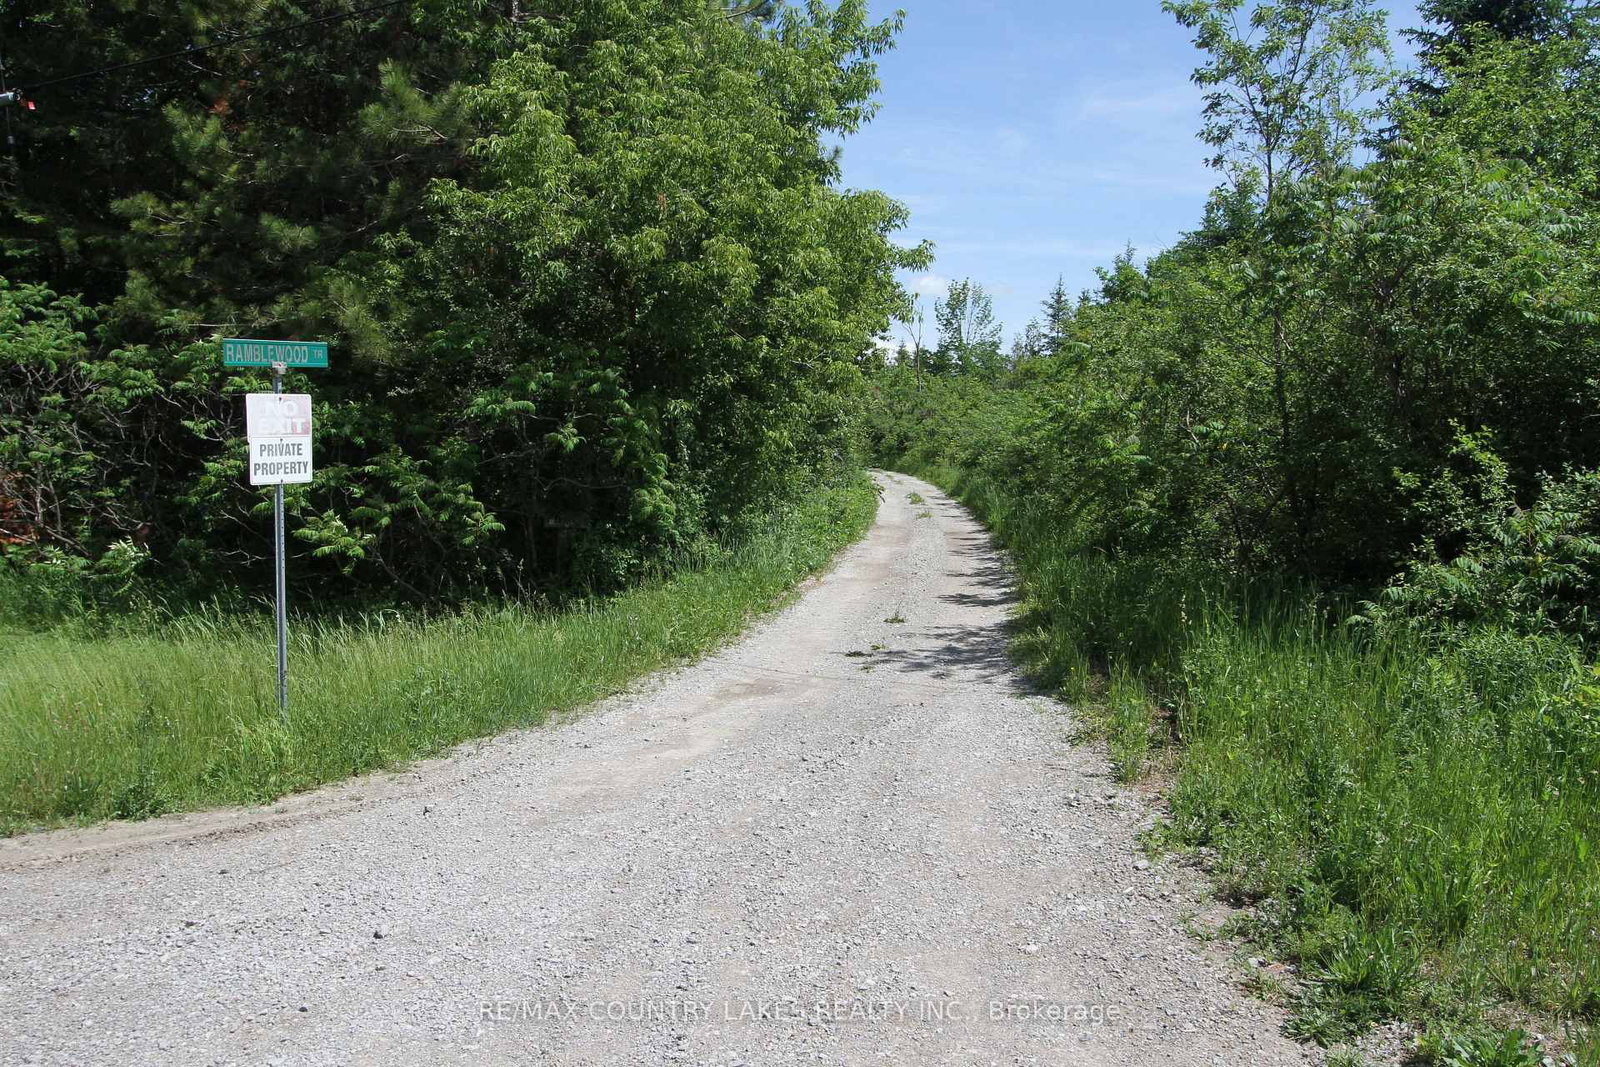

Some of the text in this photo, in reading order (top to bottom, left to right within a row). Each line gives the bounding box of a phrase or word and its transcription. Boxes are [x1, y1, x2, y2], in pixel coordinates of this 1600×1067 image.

[226, 343, 323, 363] RAMBLEWOOD TR
[262, 400, 299, 417] NO
[260, 418, 306, 433] EXIT
[259, 443, 303, 457] PRIVATE
[254, 461, 308, 476] PROPERTY
